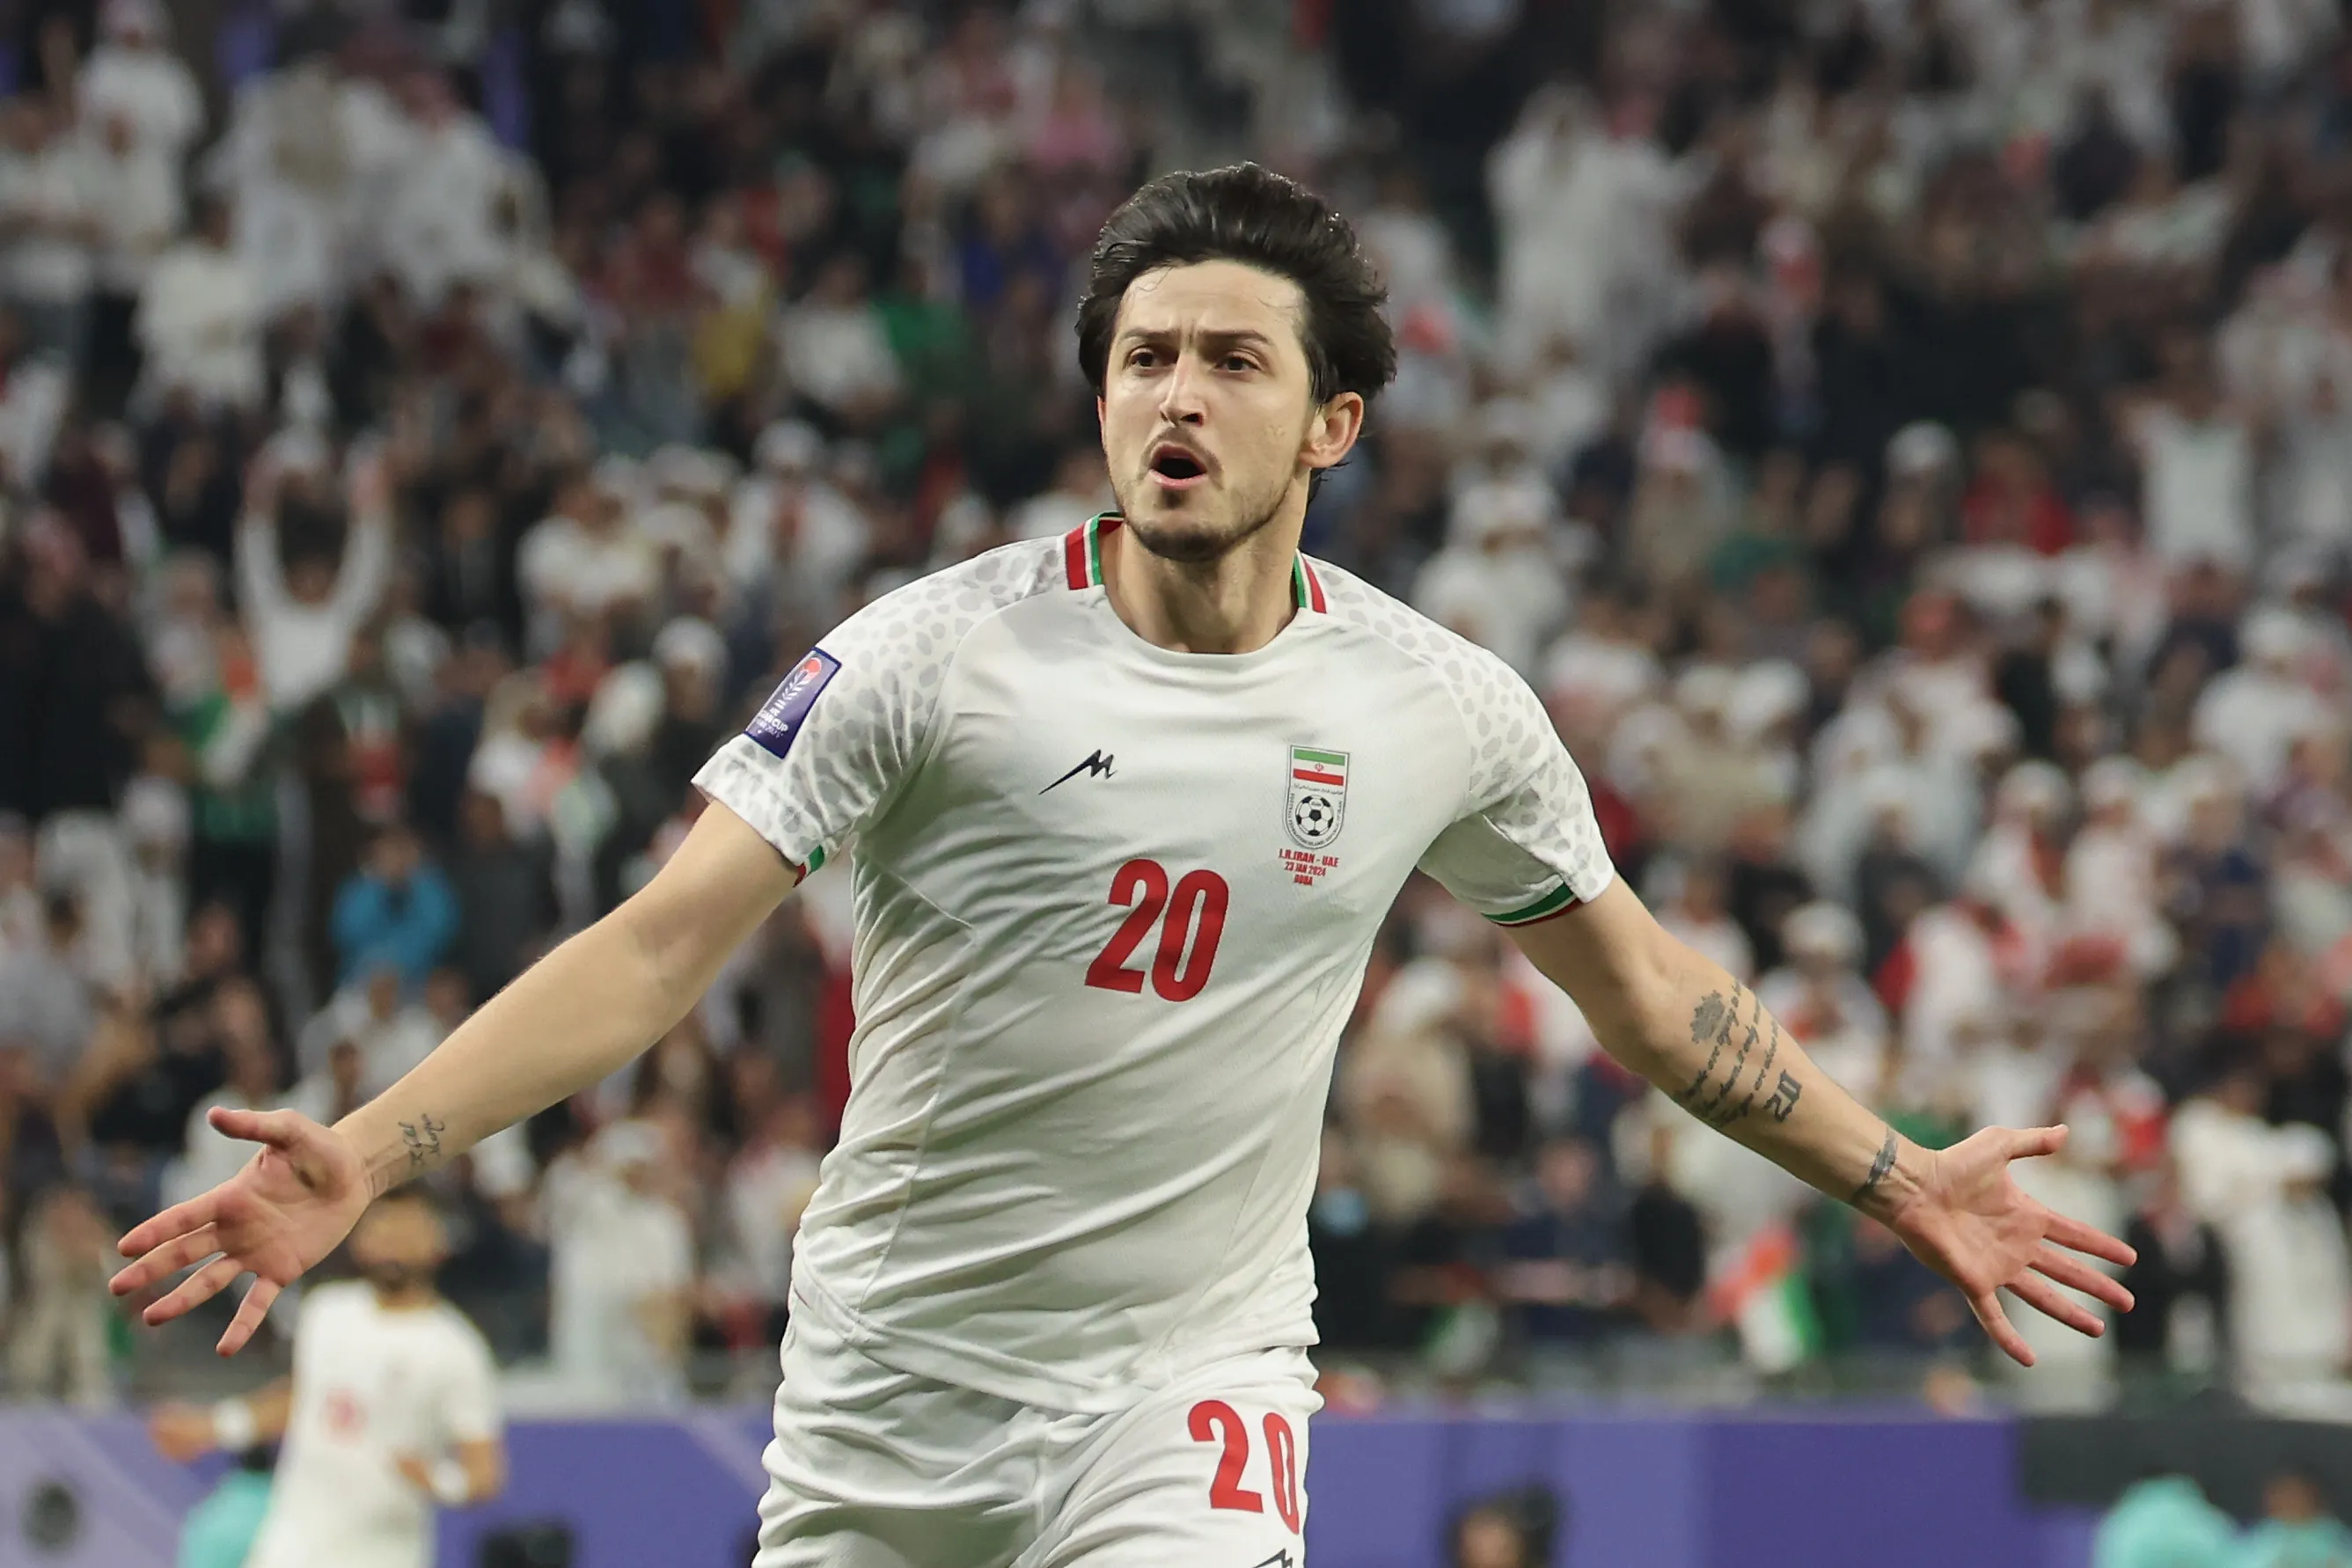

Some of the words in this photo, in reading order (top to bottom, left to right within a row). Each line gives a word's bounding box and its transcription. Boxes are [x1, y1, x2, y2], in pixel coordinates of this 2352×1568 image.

[772, 718, 788, 731] CUP
[1322, 855, 1339, 868] UAE
[1085, 859, 1228, 1002] 20
[1188, 1400, 1300, 1535] 20
